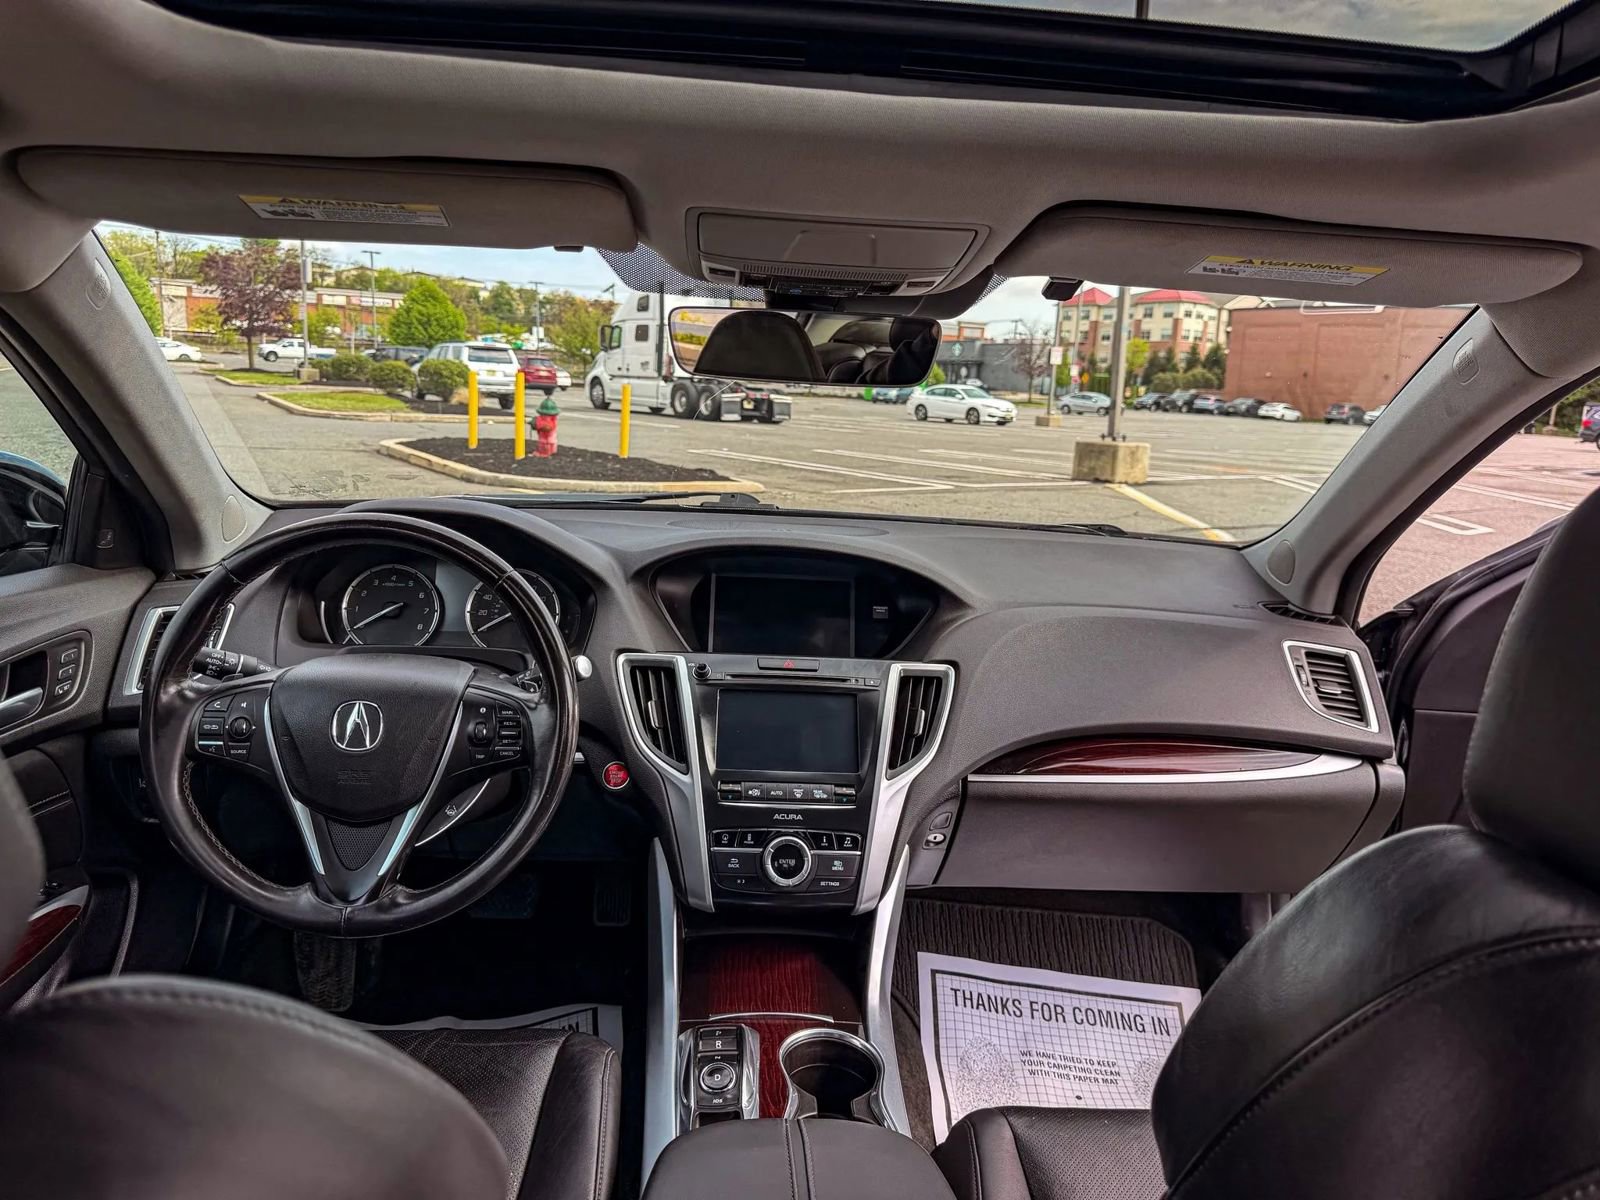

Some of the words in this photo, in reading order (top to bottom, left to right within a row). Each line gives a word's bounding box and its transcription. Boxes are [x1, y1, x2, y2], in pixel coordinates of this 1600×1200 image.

[1260, 260, 1354, 271] WARNING
[950, 987, 1023, 1018] THANKS
[1029, 1001, 1066, 1024] FOR
[1072, 1006, 1146, 1033] COMING
[1151, 1016, 1171, 1037] IN
[1022, 1059, 1045, 1067] YOUR
[1047, 1061, 1092, 1075] CARPETING
[1094, 1068, 1121, 1077] CLEAN
[1035, 1050, 1057, 1060] HAVE
[1058, 1054, 1081, 1064] TRIED
[1083, 1058, 1095, 1066] TO
[1096, 1060, 1117, 1068] KEEP
[1027, 1069, 1050, 1077] WITH
[1052, 1071, 1071, 1081] THIS
[1073, 1074, 1100, 1084] PAPER
[1101, 1077, 1119, 1085] MAT
